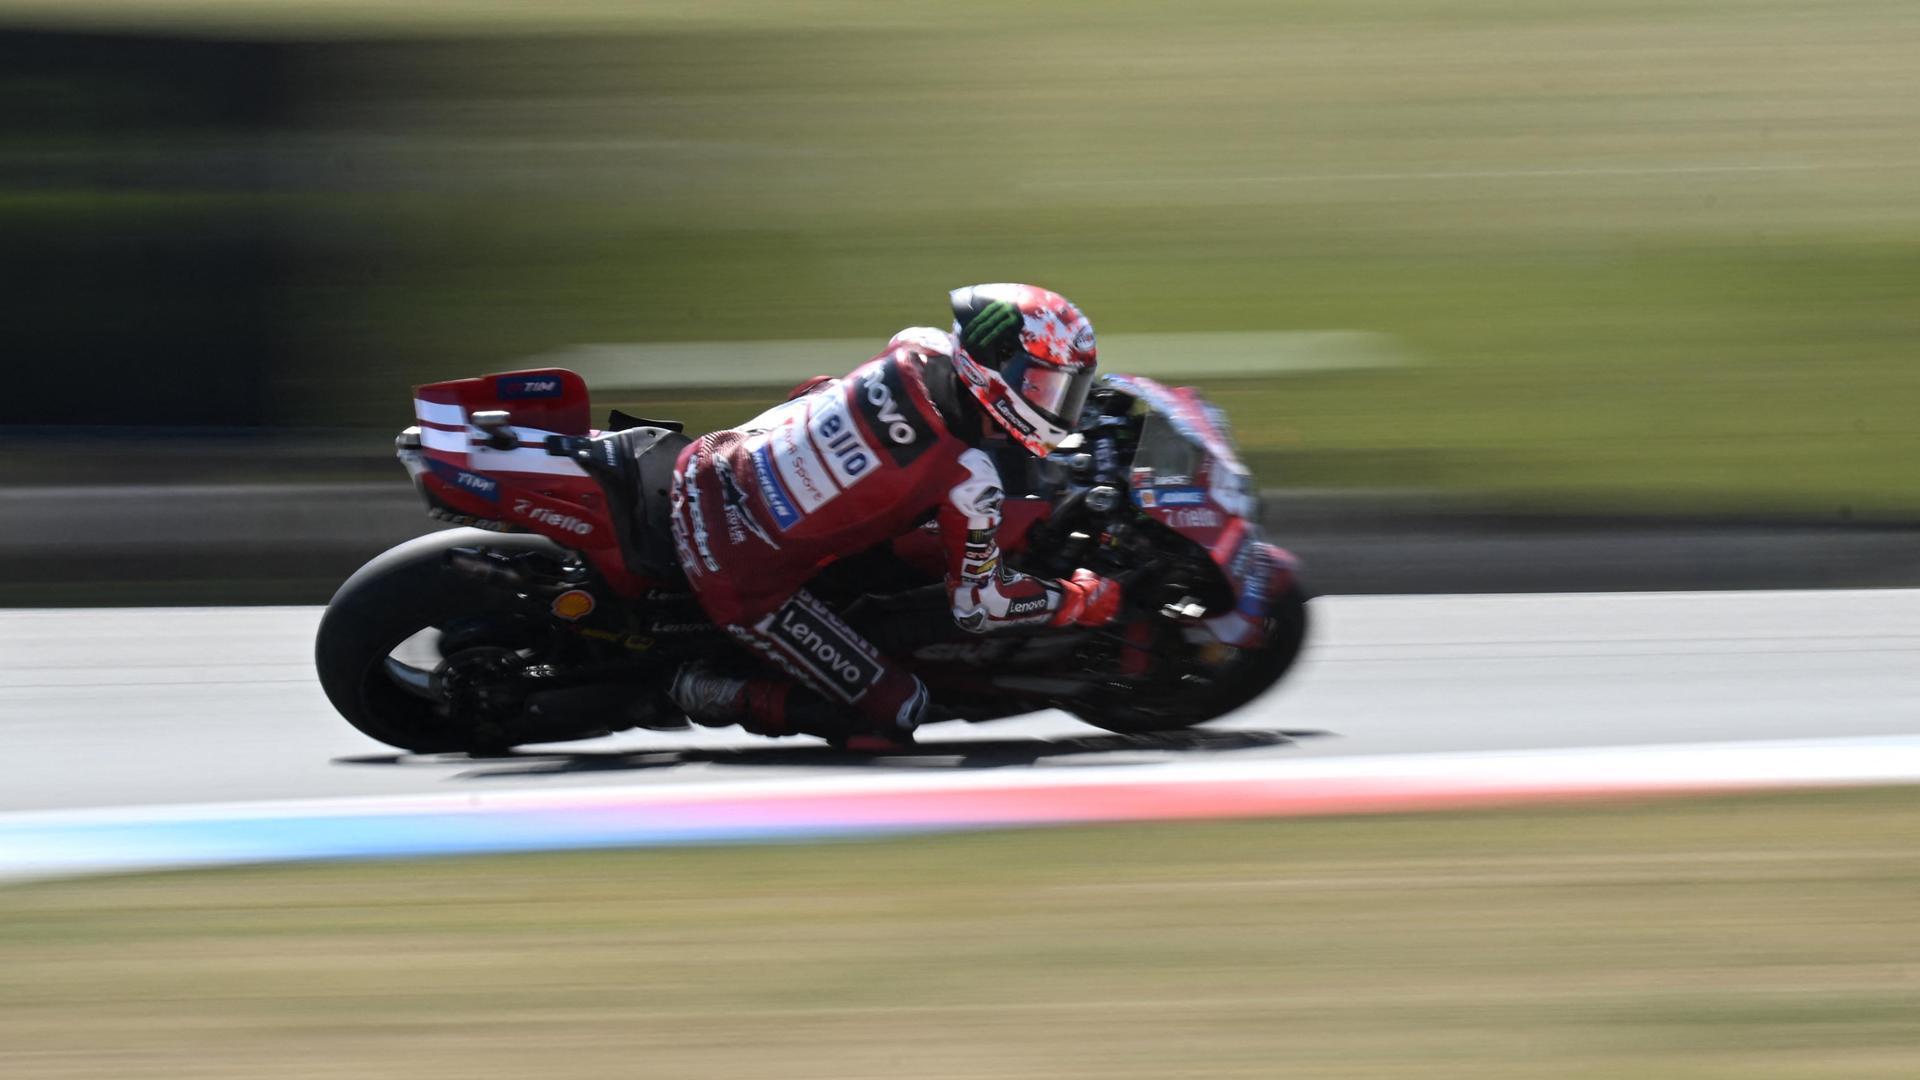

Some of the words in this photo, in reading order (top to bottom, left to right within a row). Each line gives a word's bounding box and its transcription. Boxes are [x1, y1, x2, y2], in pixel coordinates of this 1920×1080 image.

[523, 381, 556, 392] TIM
[864, 362, 917, 444] novo
[752, 450, 793, 518] MICHELIN
[1010, 598, 1046, 613] Lenovo
[780, 609, 861, 683] Lenovo
